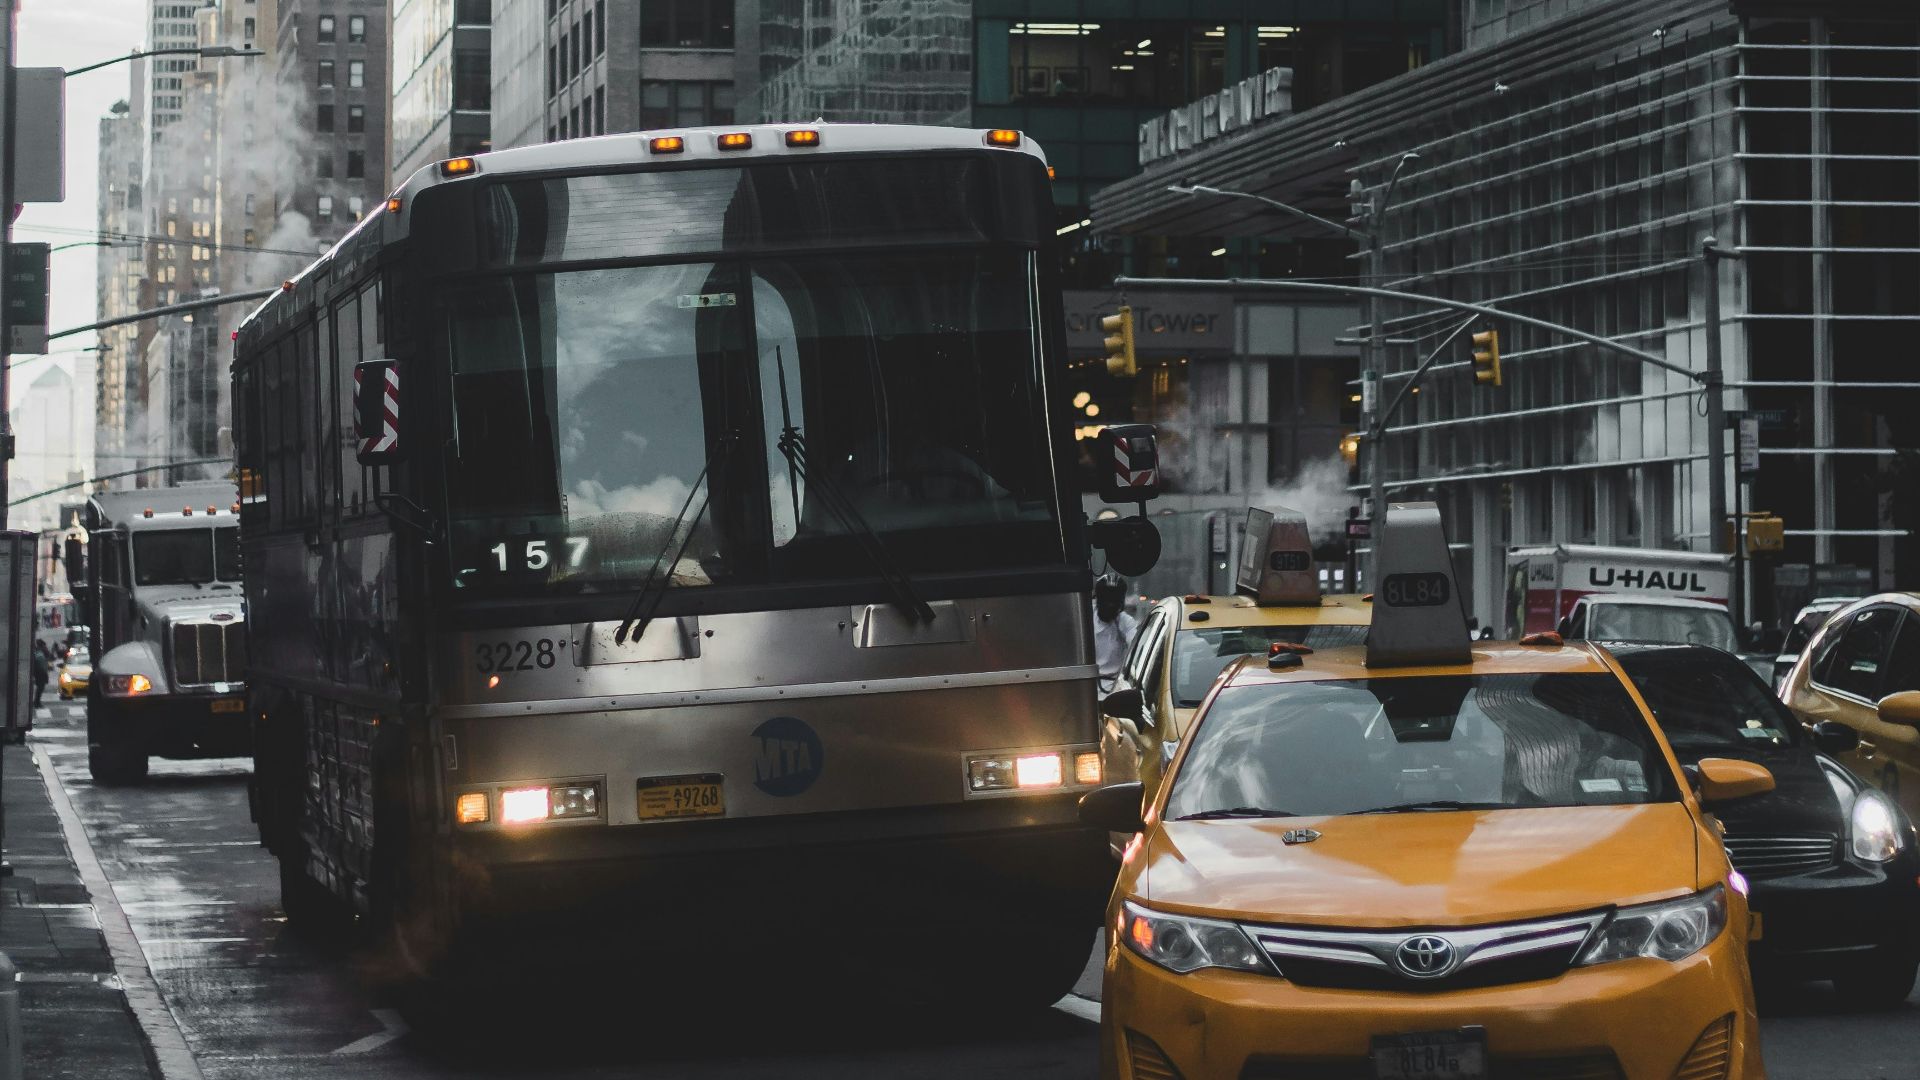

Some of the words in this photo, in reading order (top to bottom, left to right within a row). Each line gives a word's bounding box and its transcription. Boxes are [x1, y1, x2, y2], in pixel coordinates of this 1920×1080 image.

[1134, 305, 1220, 333] Tower
[1387, 577, 1443, 605] 8L84
[1589, 567, 1706, 592] U-HAUL
[476, 637, 556, 673] 3228
[752, 736, 813, 784] MTA
[683, 786, 718, 808] 9268
